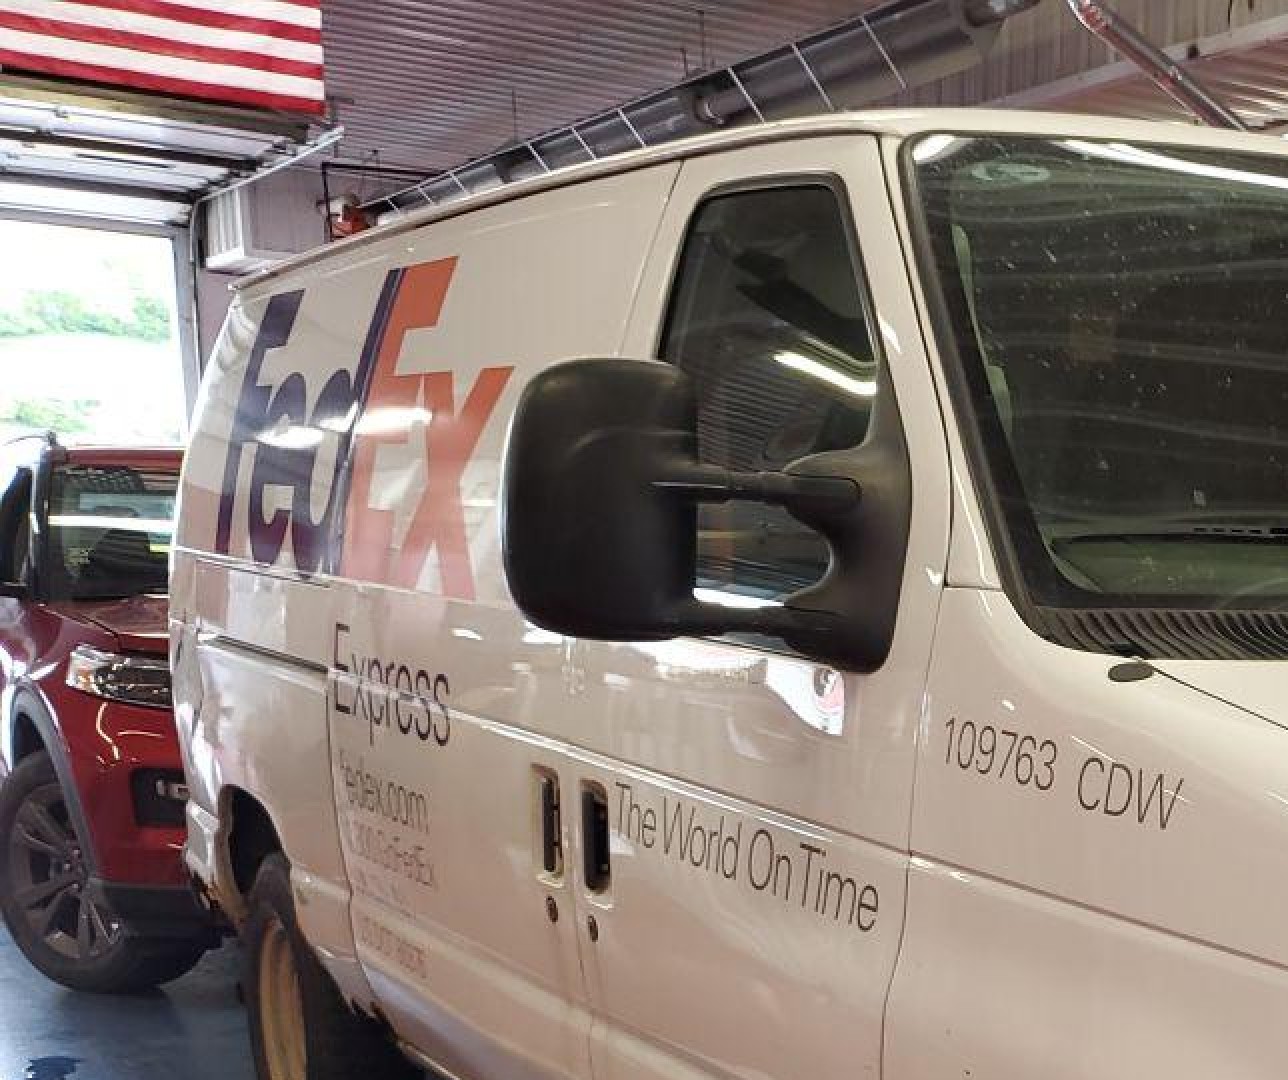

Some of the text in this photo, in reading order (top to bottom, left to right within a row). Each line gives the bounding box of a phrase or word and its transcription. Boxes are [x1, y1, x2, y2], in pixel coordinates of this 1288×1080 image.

[215, 255, 515, 602] FedEx
[332, 622, 452, 747] Express
[944, 716, 1185, 831] 109763 CDW
[615, 781, 880, 933] The World On Time
